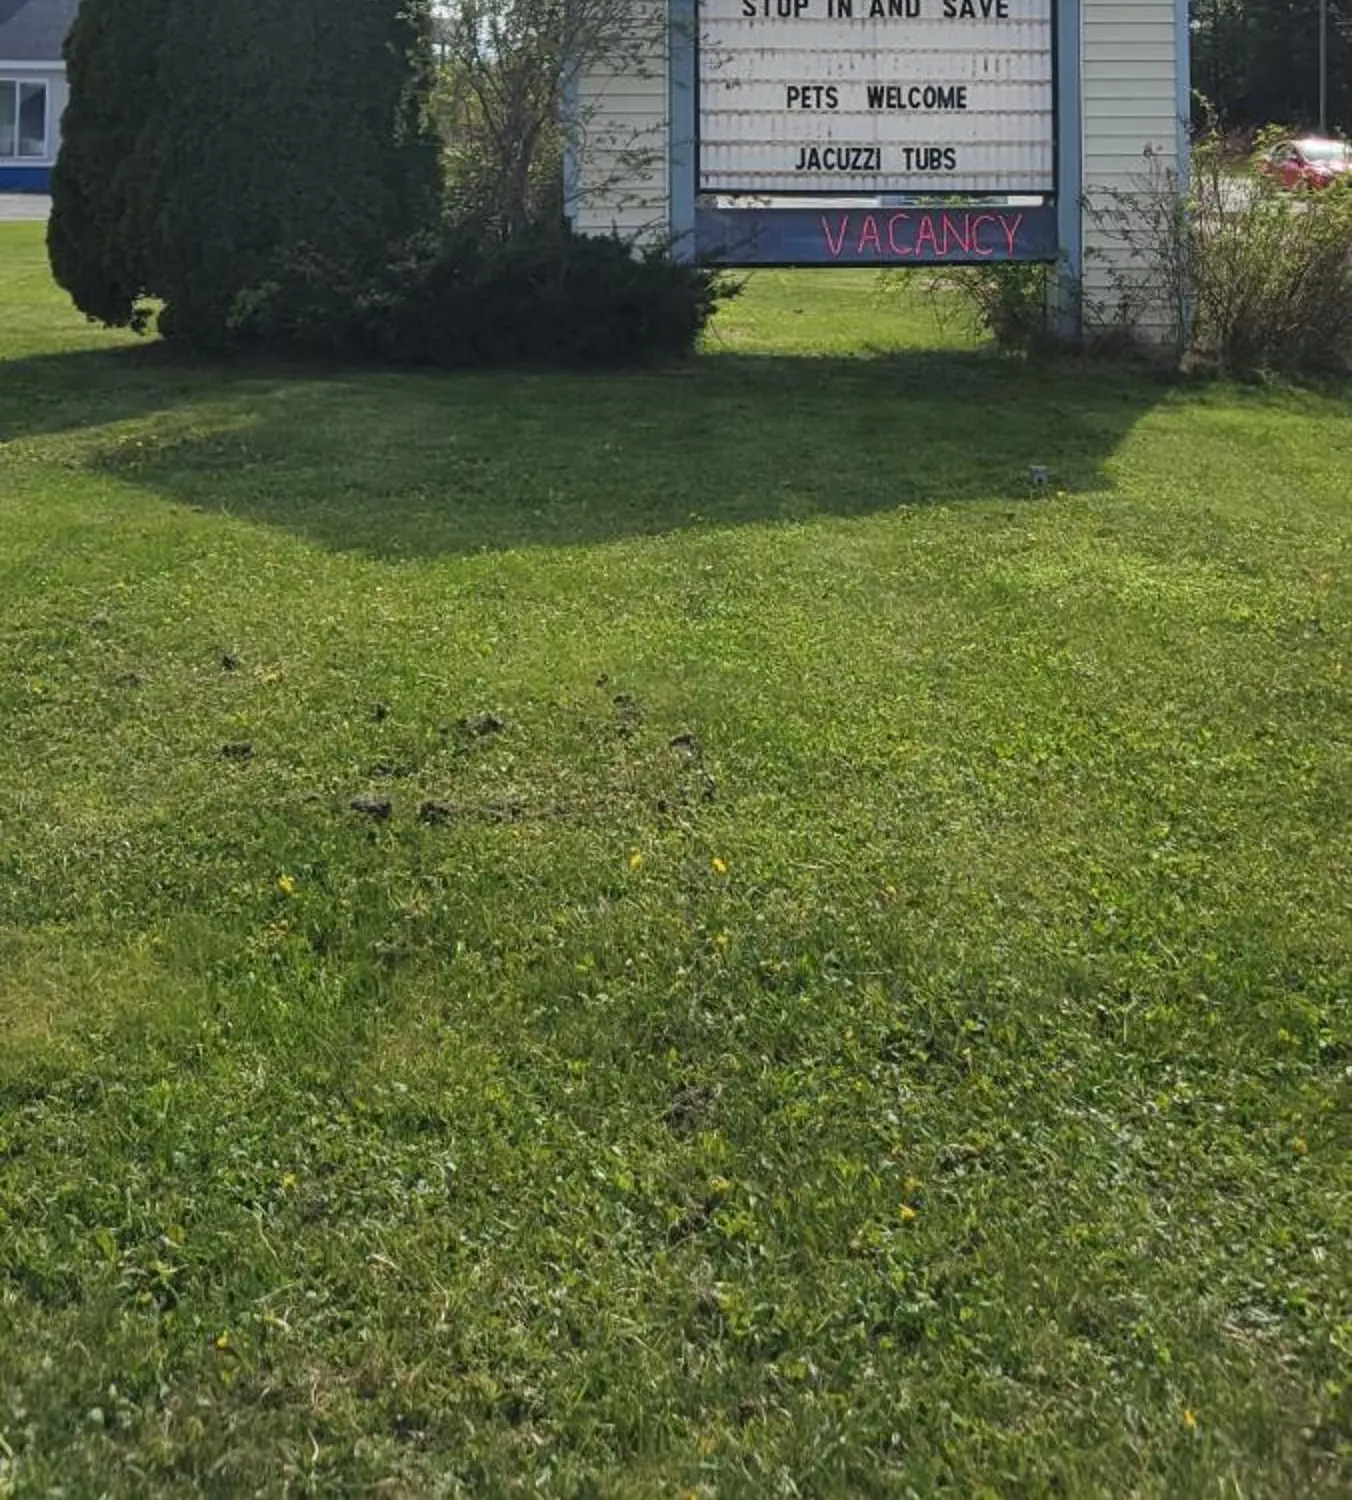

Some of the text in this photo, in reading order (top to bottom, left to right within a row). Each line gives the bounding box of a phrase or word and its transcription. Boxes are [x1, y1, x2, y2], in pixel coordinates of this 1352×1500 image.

[786, 86, 967, 109] PETS WELCOME
[795, 148, 957, 171] JACUZZI TUBS
[821, 213, 1023, 257] VACANCY
